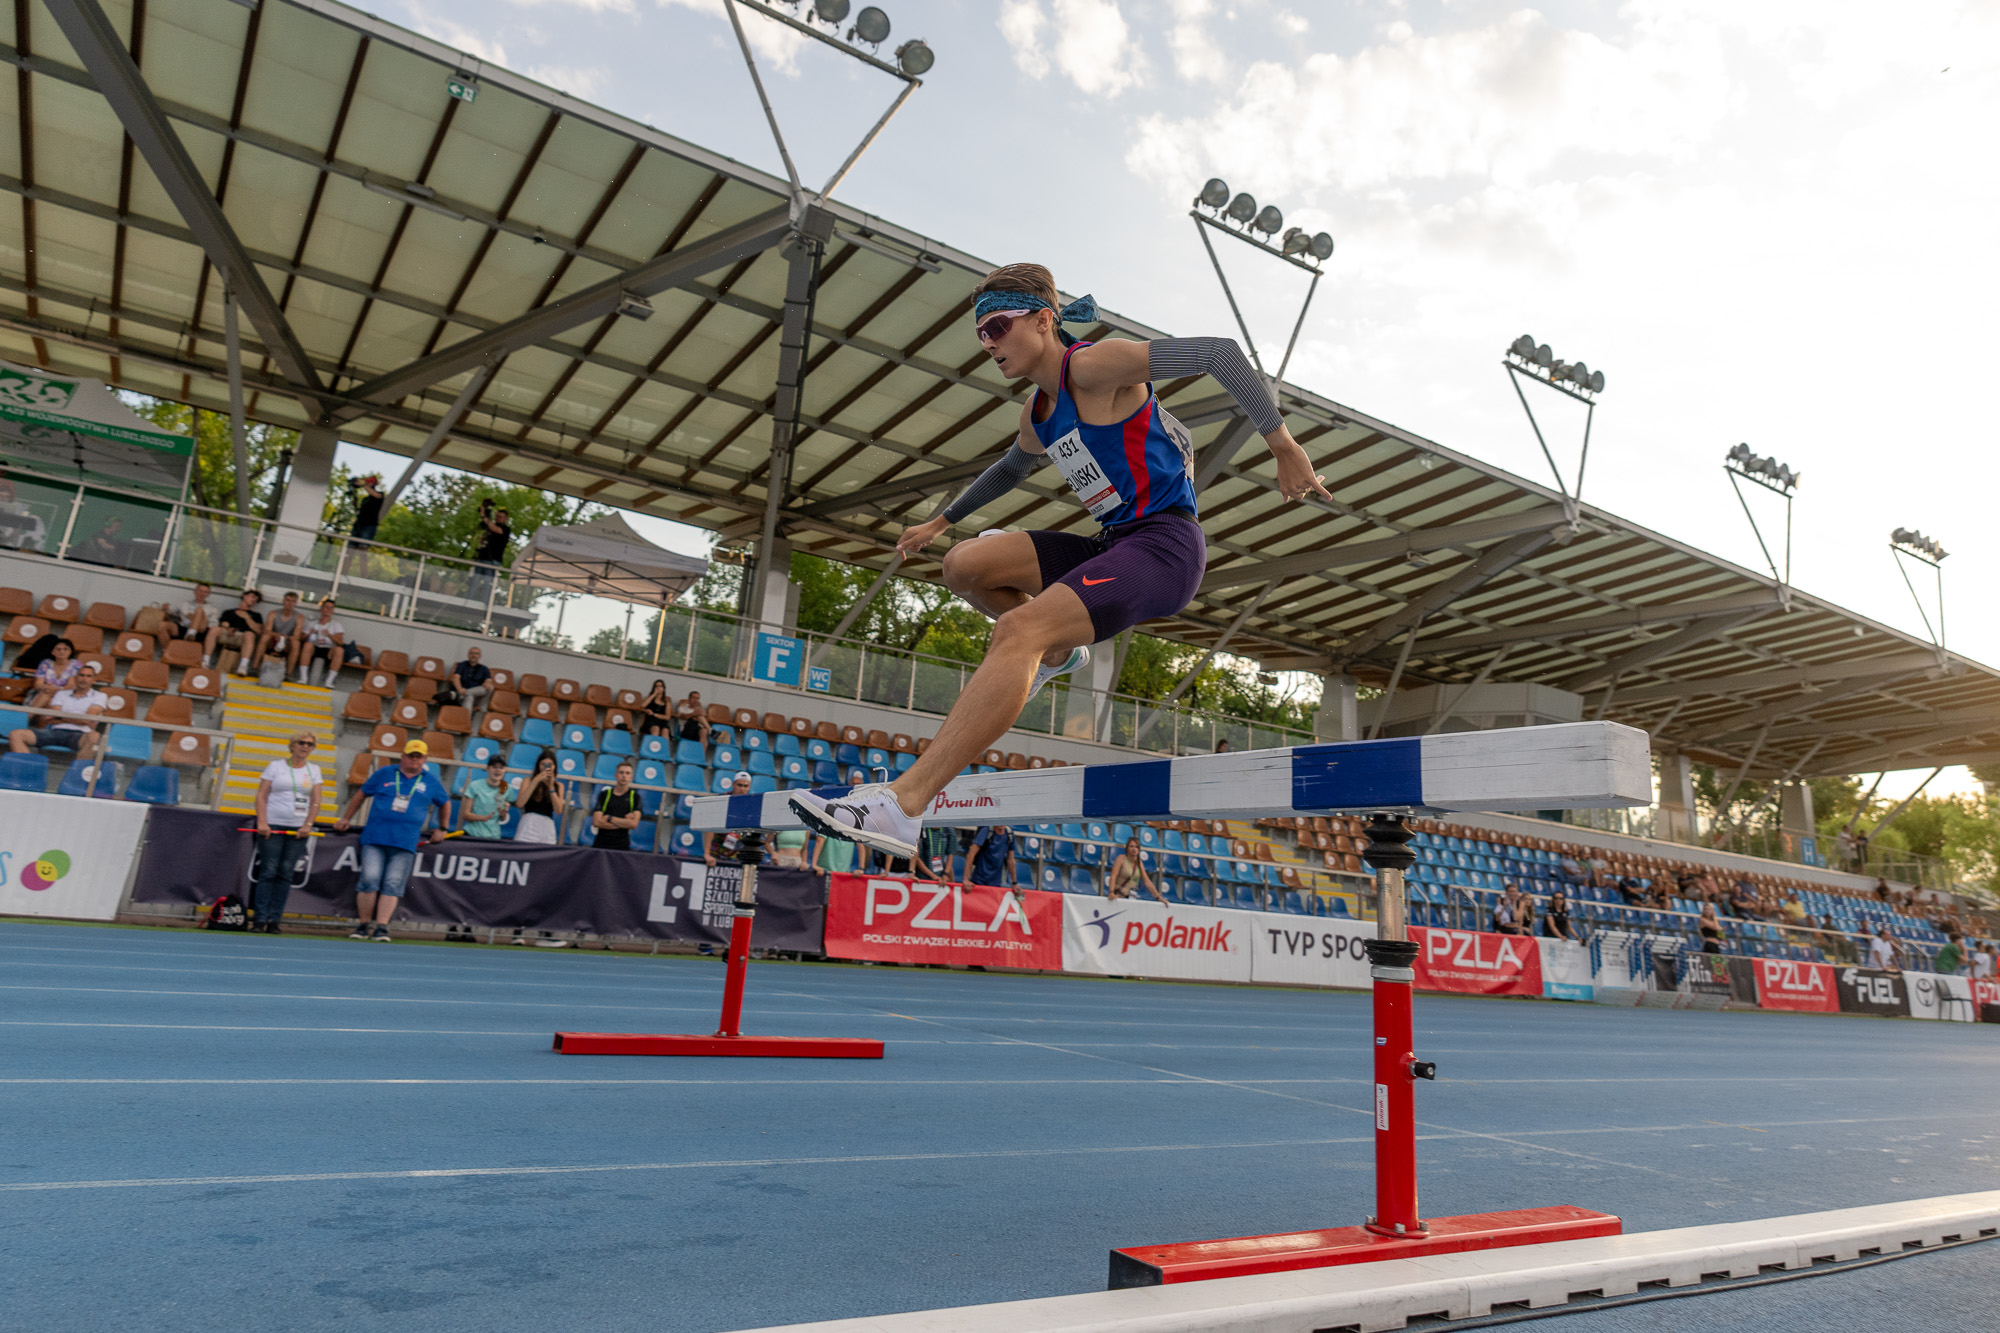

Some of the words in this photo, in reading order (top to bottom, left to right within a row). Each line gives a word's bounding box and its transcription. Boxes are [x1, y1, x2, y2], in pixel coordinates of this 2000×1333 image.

[1058, 437, 1079, 459] 431
[766, 636, 795, 648] SEKTOR
[767, 647, 790, 678] F
[811, 670, 828, 682] WC
[412, 851, 531, 886] LUBLIN
[864, 879, 1032, 935] PZLA
[863, 933, 902, 944] POLSKI
[903, 936, 950, 947] ZWIĄZEK
[952, 938, 991, 949] LEKKIEJ
[993, 940, 1033, 951] ATLETYKI
[1121, 915, 1232, 954] polanik
[1268, 929, 1314, 956] TVP
[1322, 933, 1365, 960] SPO
[1427, 929, 1523, 970] PZLA
[1763, 960, 1825, 992] PZLA
[1857, 976, 1900, 1005] FUEL
